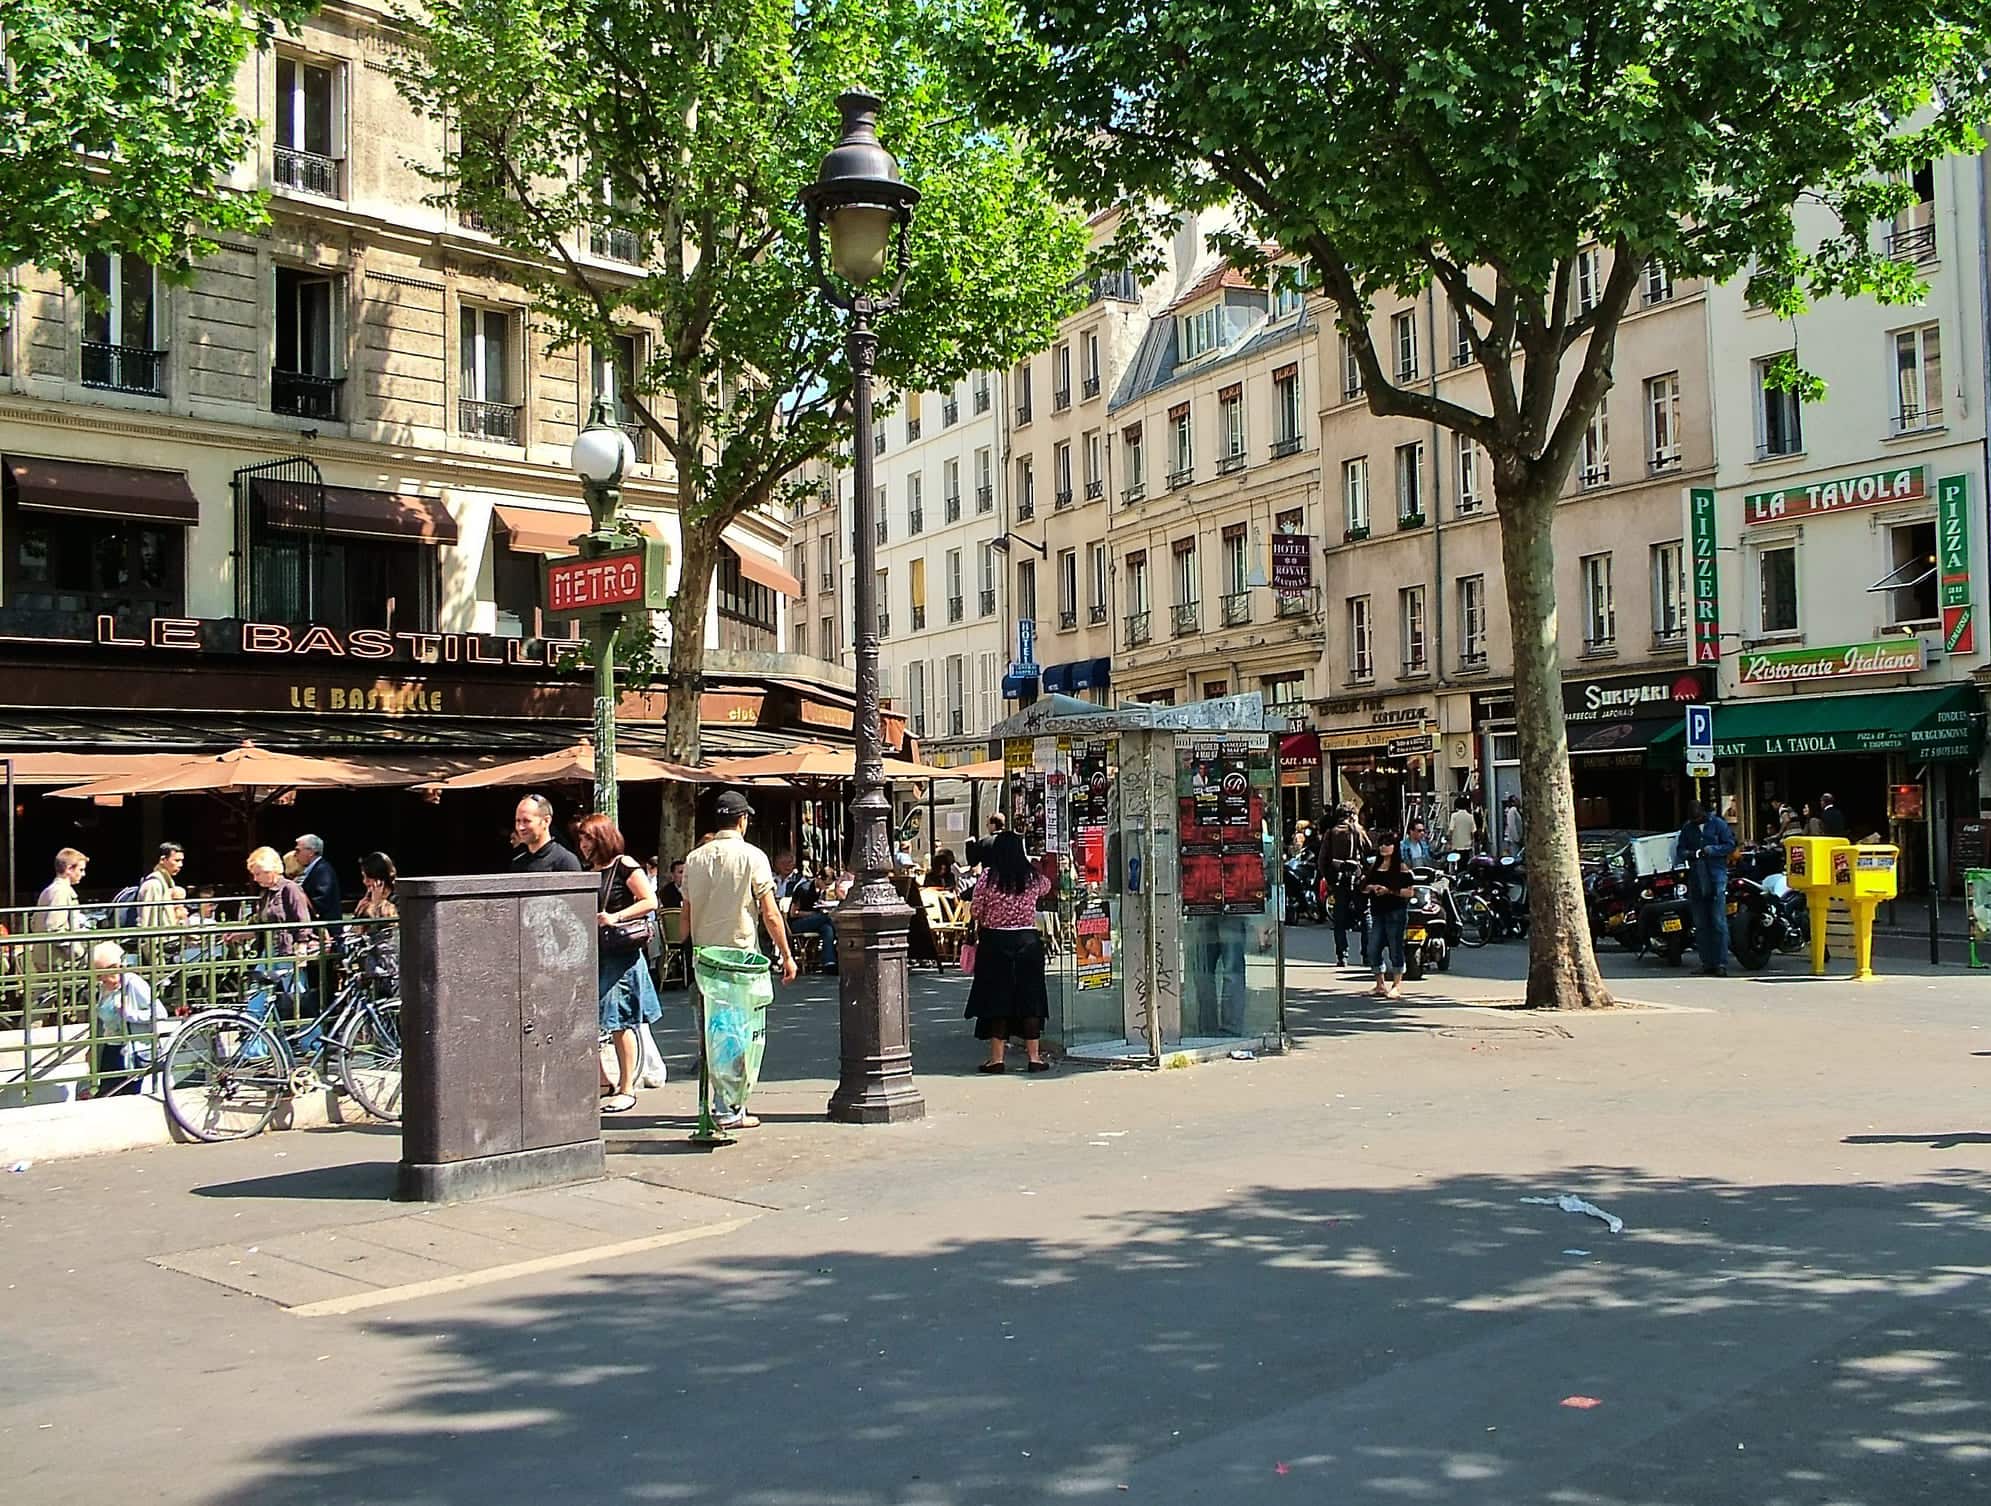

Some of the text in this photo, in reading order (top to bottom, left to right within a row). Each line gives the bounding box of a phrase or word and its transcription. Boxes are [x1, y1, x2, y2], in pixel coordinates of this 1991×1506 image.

[1755, 470, 1911, 518] LA TAVOLA
[1945, 486, 1962, 568] PIZZA
[1273, 543, 1308, 555] HOTEL
[555, 563, 636, 605] METRO
[1695, 496, 1715, 660] PIZZERIA
[97, 614, 595, 668] LE BASTILLE
[1021, 623, 1031, 664] HOTEL
[1743, 646, 1916, 682] Ristorante Italiano
[290, 686, 443, 713] LE BASTILLE
[728, 707, 757, 721] club
[1695, 714, 1705, 740] P
[1766, 739, 1783, 753] LA
[1787, 736, 1836, 752] TAVOLA
